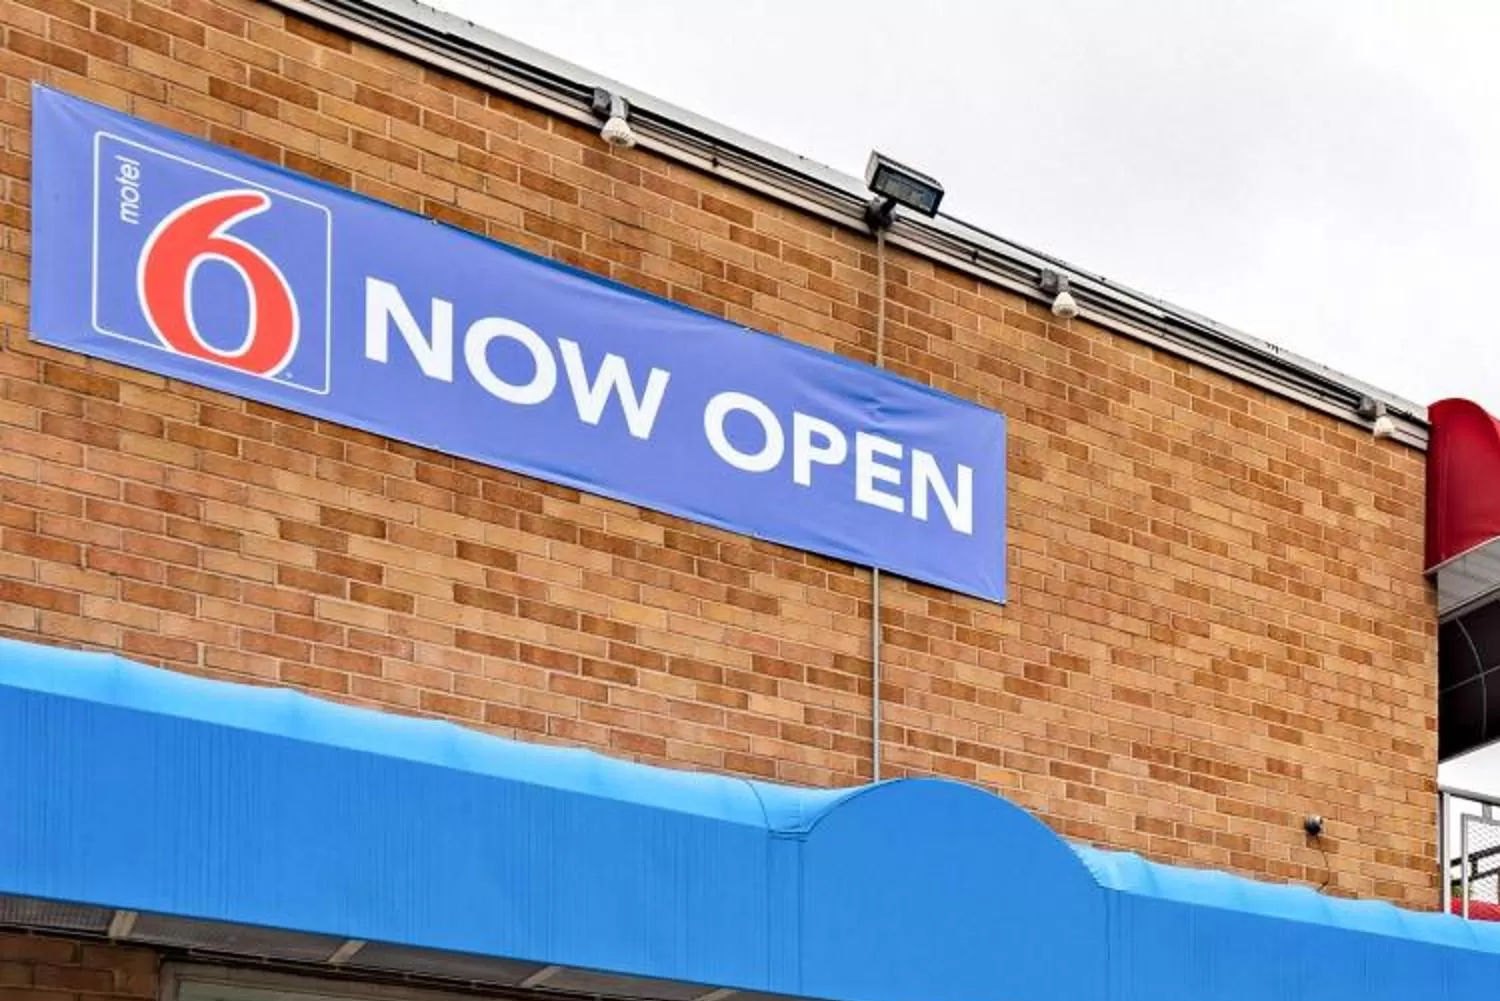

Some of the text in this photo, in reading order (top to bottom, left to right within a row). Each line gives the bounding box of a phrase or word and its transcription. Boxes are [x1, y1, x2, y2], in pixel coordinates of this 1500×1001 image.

[114, 155, 140, 224] motel
[138, 189, 300, 377] 6
[365, 277, 974, 535] NOW OPEN
